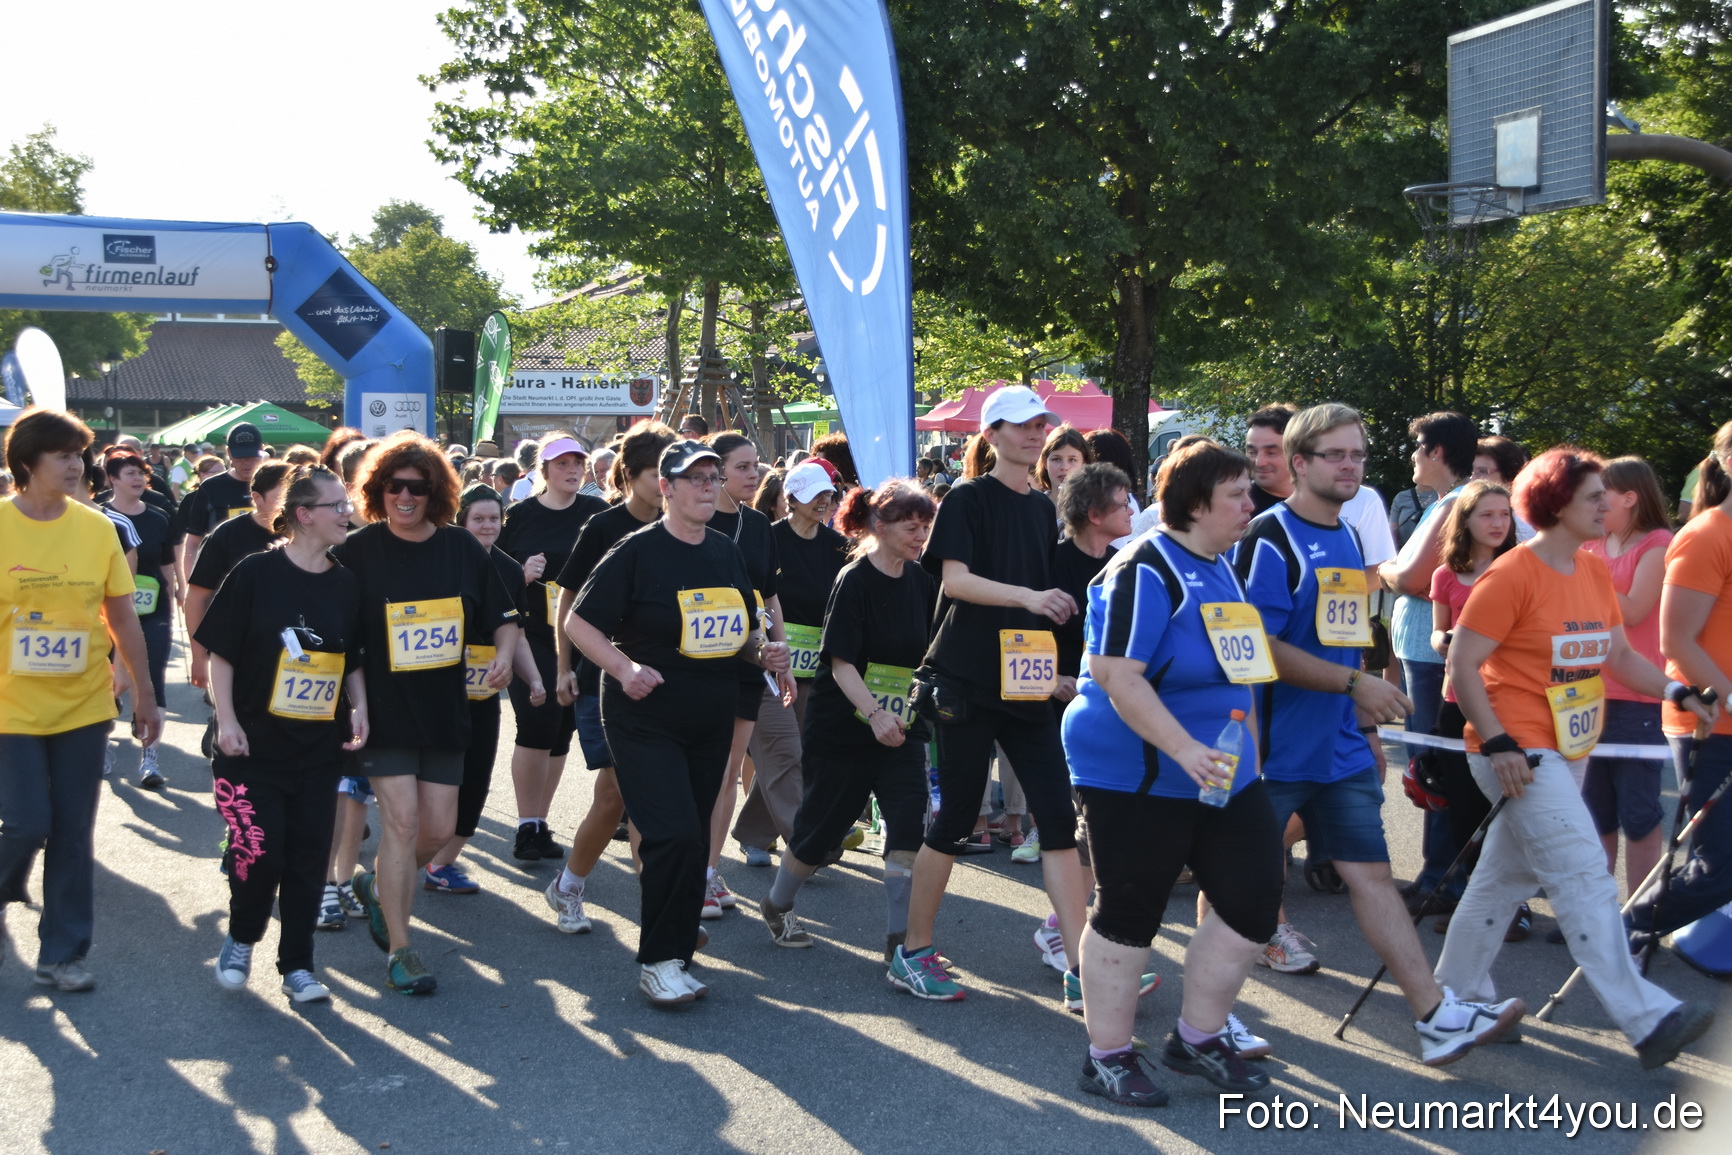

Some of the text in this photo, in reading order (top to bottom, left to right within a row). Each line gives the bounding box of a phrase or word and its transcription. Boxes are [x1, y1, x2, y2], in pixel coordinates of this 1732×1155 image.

[115, 246, 154, 254] Fischer
[86, 264, 200, 286] firmenlauf
[316, 307, 332, 316] und
[333, 306, 349, 314] das
[505, 376, 545, 389] Jura
[18, 575, 59, 584] Seniorenstift
[134, 591, 154, 606] 23
[1326, 599, 1358, 625] 813
[690, 614, 744, 640] 1274
[1562, 620, 1605, 632] 30 Jahre
[19, 635, 82, 659] 1341
[398, 625, 459, 651] 1254
[1219, 634, 1255, 661] 809
[1560, 638, 1610, 659] OBI
[790, 648, 821, 670] 192
[1008, 658, 1054, 681] 1255
[466, 667, 489, 685] 27
[284, 676, 337, 701] 1278
[1569, 705, 1599, 738] 607
[215, 777, 244, 844] Dance
[232, 799, 267, 857] New York
